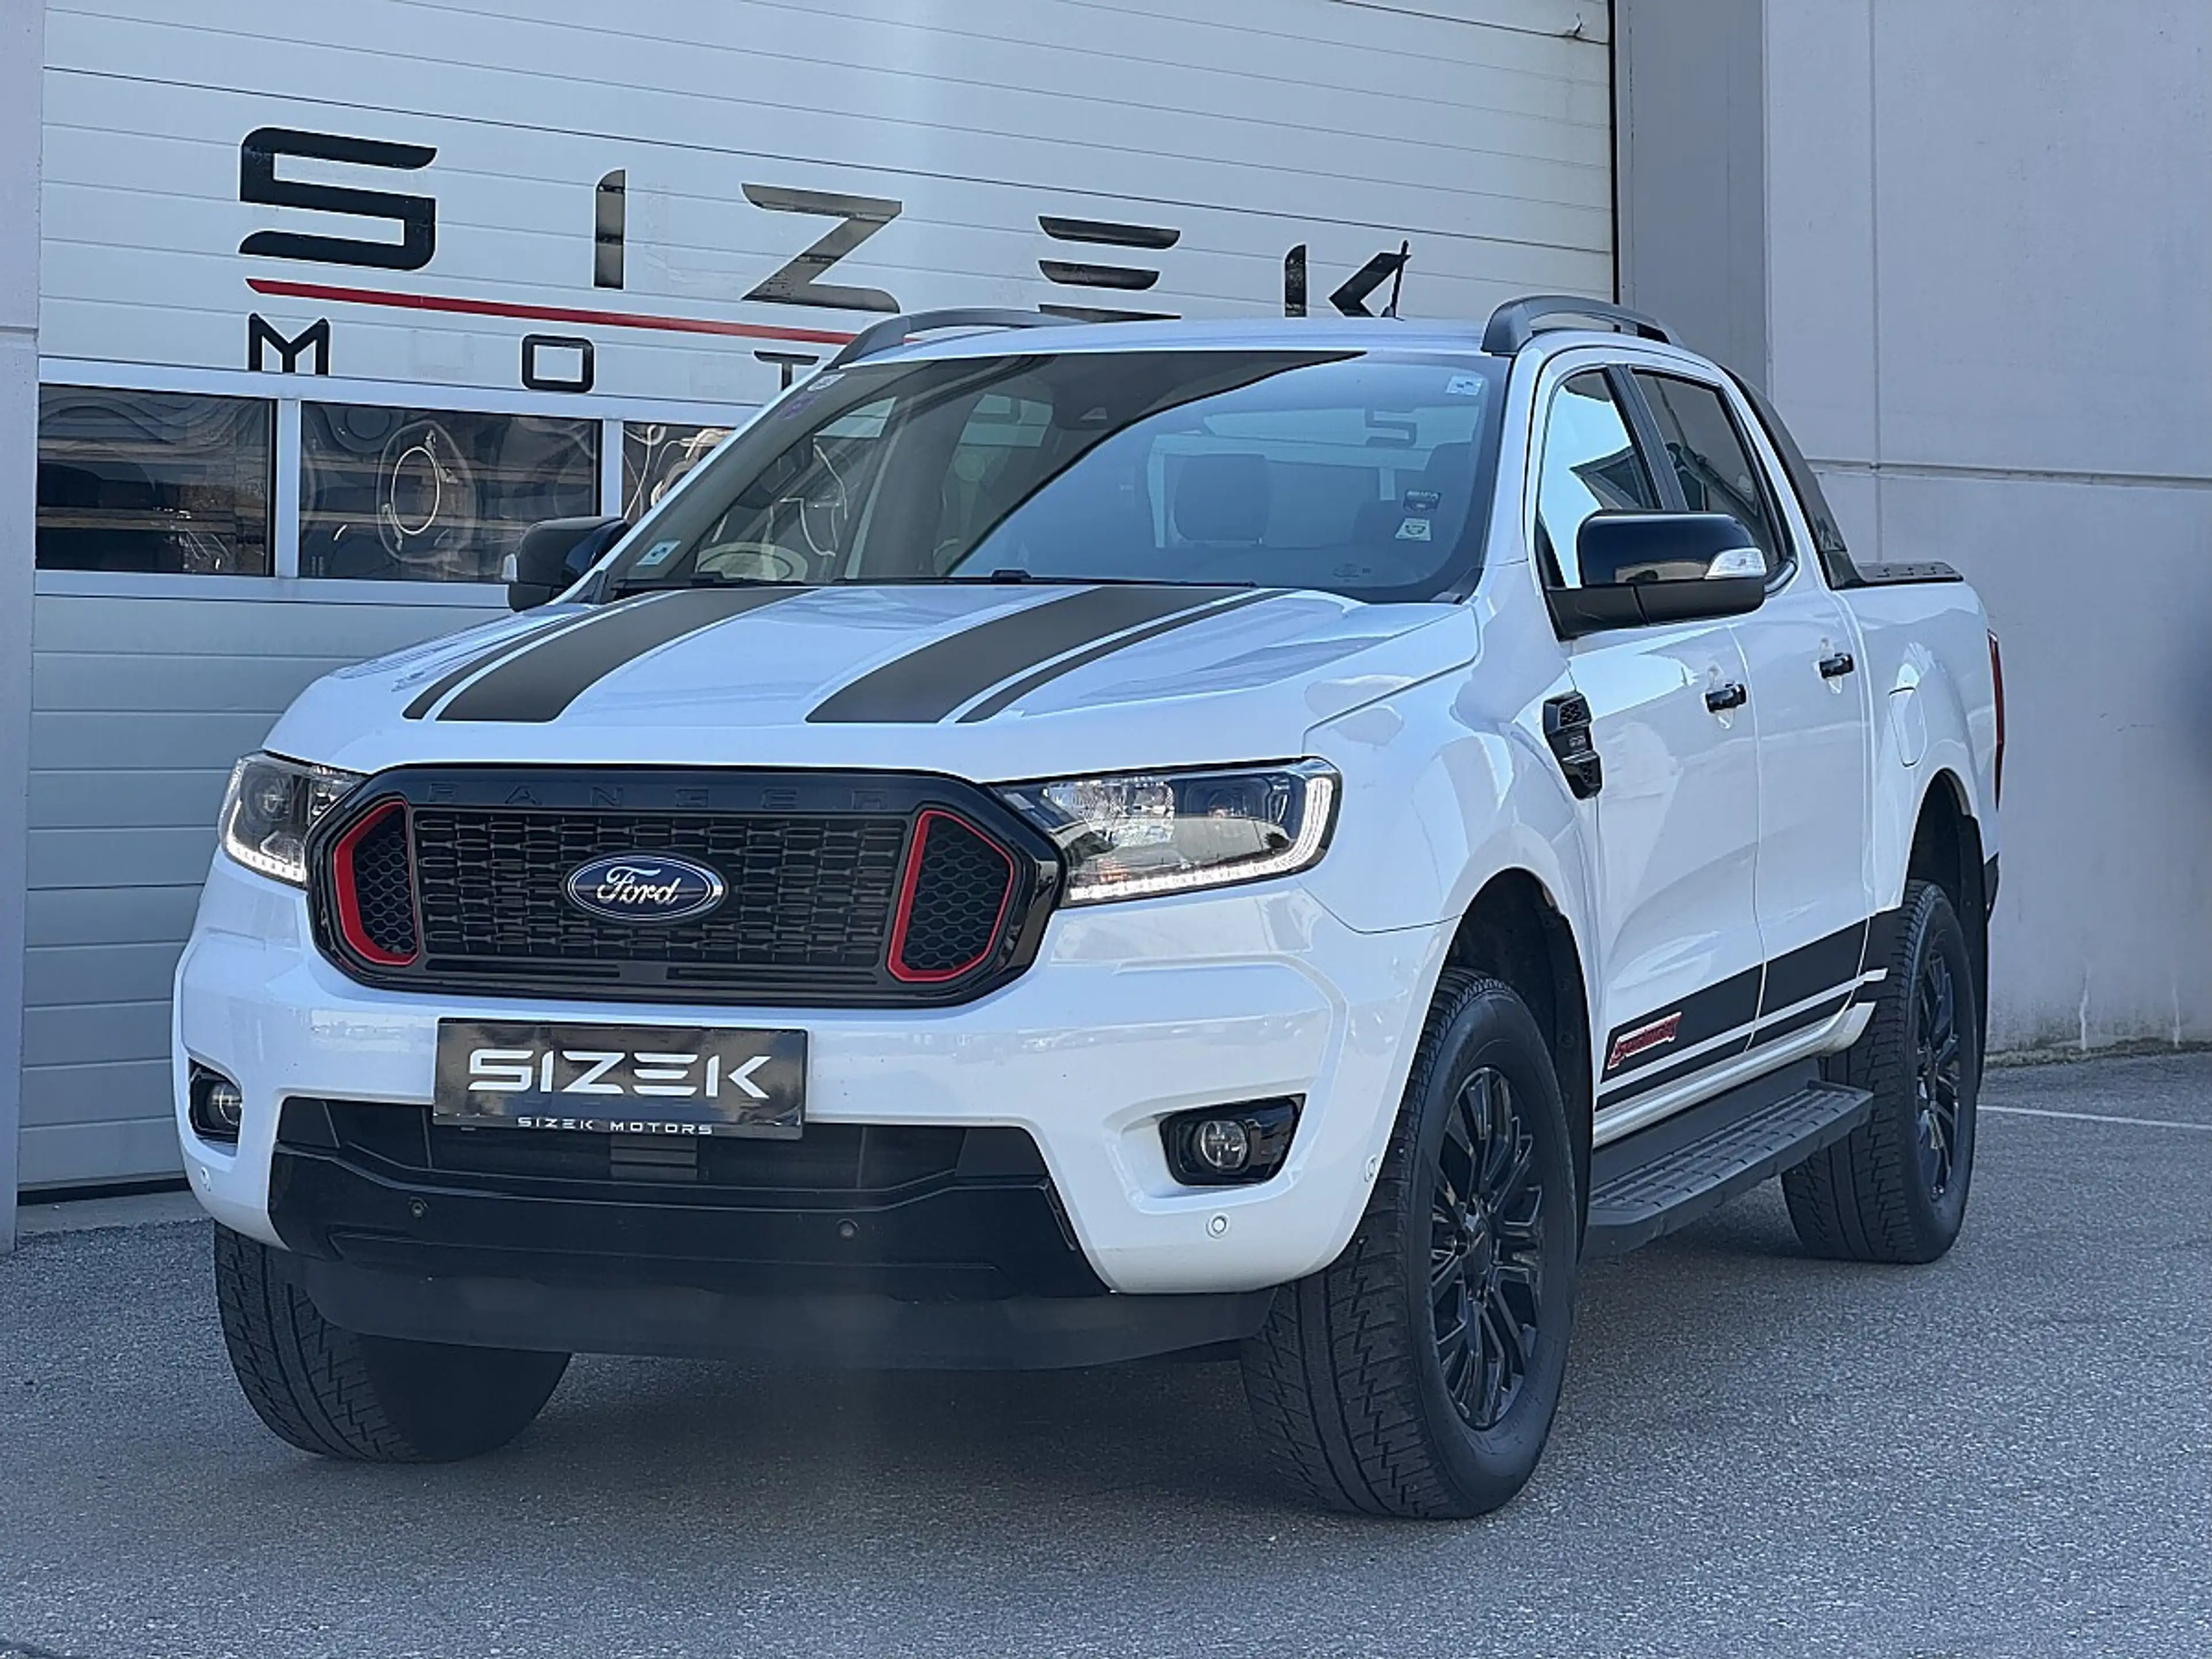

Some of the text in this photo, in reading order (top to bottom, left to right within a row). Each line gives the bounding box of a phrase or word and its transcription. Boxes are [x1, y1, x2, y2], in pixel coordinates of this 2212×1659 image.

[240, 127, 1411, 322] SIZEK
[426, 782, 888, 810] RANGER
[596, 865, 681, 905] Ford
[468, 1048, 772, 1099] SIZEK
[518, 1116, 713, 1135] SIZEK MOTORS
